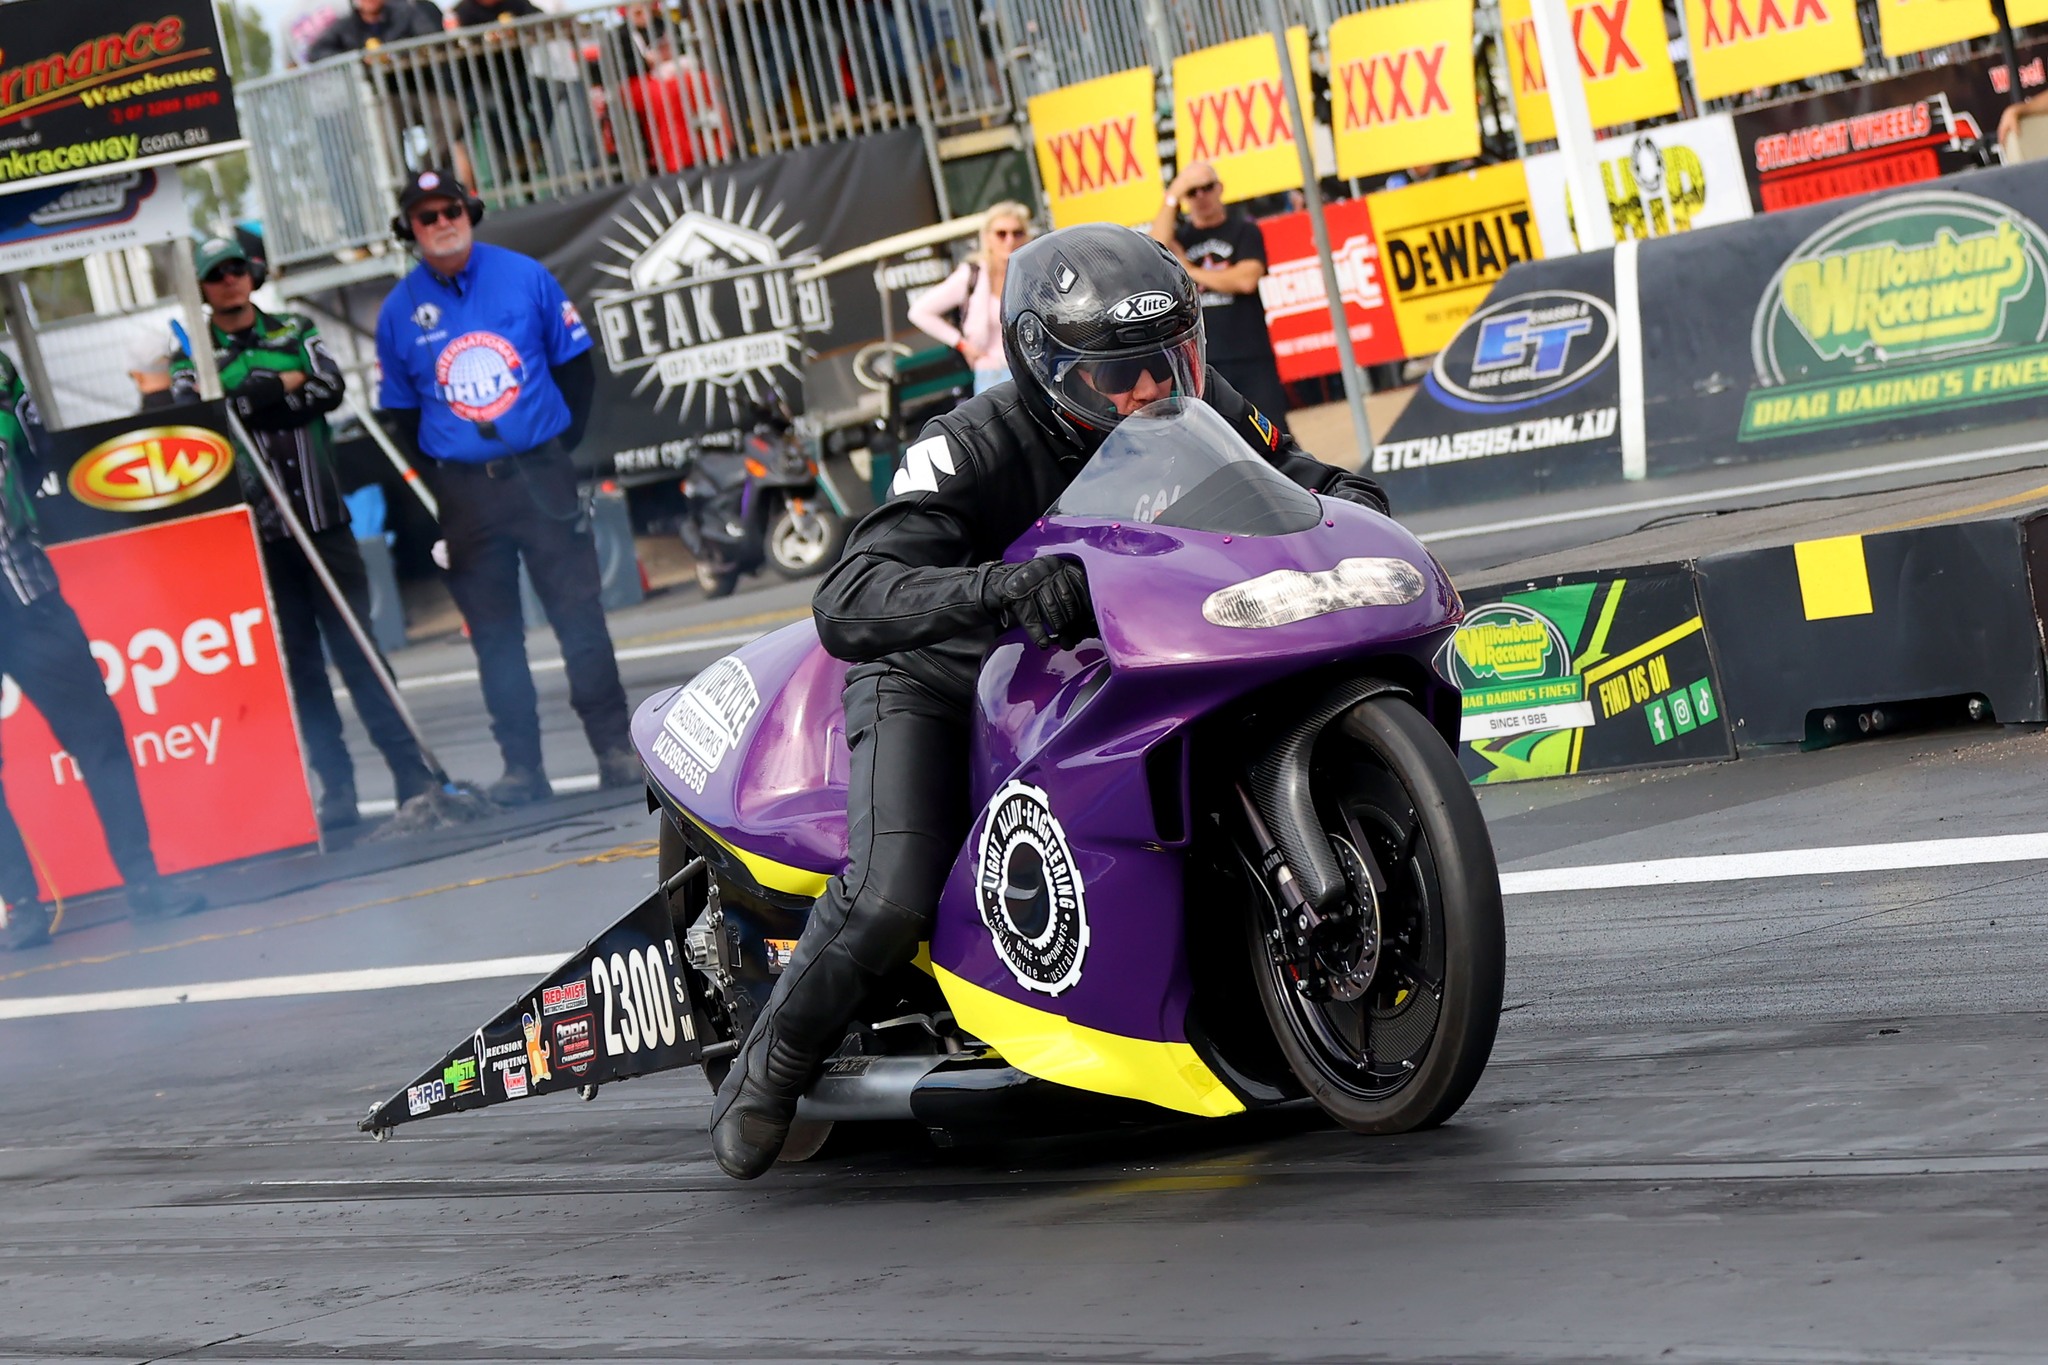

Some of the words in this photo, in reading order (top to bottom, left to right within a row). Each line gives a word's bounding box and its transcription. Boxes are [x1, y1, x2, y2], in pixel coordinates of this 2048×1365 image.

[79, 66, 217, 109] Warehouse
[1339, 45, 1452, 131] XXXX
[1187, 80, 1296, 161] XXXX
[1755, 122, 1848, 173] STRAIGHT
[1849, 101, 1931, 150] WHEELS
[1047, 115, 1144, 198] XXXX
[1125, 297, 1168, 319] X-lite
[1782, 220, 2025, 340] Willowbank
[1856, 274, 1998, 334] Raceway
[602, 284, 722, 363] PEAK
[734, 269, 823, 334] PUB
[1475, 314, 1592, 375] ET
[1753, 393, 1829, 429] DRAG
[1836, 372, 1965, 414] RACING'S
[1372, 408, 1618, 473] ETCHASSIS.COM.AU
[1454, 618, 1549, 668] Willowbank
[1487, 645, 1542, 665] Raceway
[687, 658, 756, 741] OTORCYCLE
[1462, 696, 1483, 709] RAG
[1486, 687, 1537, 706] RACING'S
[1538, 683, 1578, 699] FINEST
[1599, 672, 1631, 719] FIND
[1627, 664, 1650, 704] US
[1648, 654, 1672, 695] ON
[1489, 716, 1520, 730] SINCE
[1521, 712, 1548, 726] 1985
[652, 730, 708, 795] 0418993559
[983, 832, 1004, 889] LIGHT
[997, 799, 1023, 838] ALLOY
[1026, 801, 1076, 910] ENGINEERING
[1016, 940, 1033, 961] BIKE
[1048, 937, 1078, 982] ustralia
[591, 944, 676, 1057] 2300
[492, 1054, 528, 1072] PORTING
